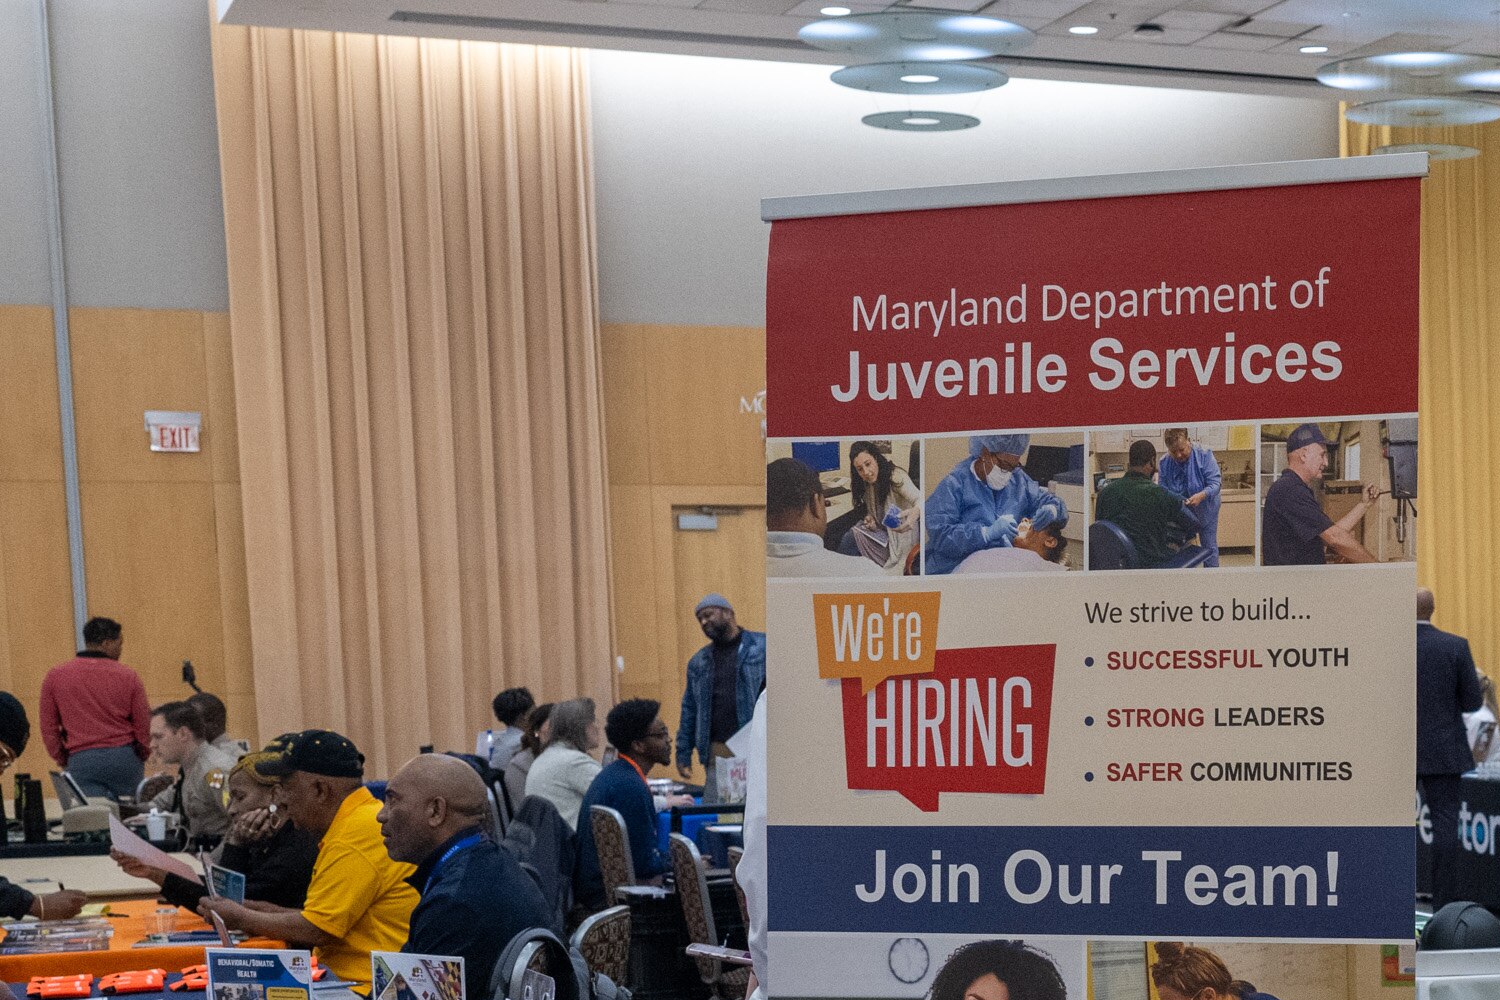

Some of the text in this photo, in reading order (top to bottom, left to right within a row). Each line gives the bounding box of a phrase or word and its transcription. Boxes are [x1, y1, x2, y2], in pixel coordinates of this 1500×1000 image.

[852, 266, 1331, 337] Maryland Department of
[830, 332, 1343, 403] Juvenile Services
[160, 426, 190, 448] EXIT
[831, 597, 922, 662] We're
[1084, 597, 1311, 624] We strive to build...
[1106, 647, 1349, 670] SUCCESSFUL YOUTH
[866, 676, 1033, 768] HIRING
[1106, 706, 1325, 728] STRONG LEADERS
[1106, 760, 1353, 782] SAFER COMMUNITIES
[855, 848, 1339, 907] Join Our Team!
